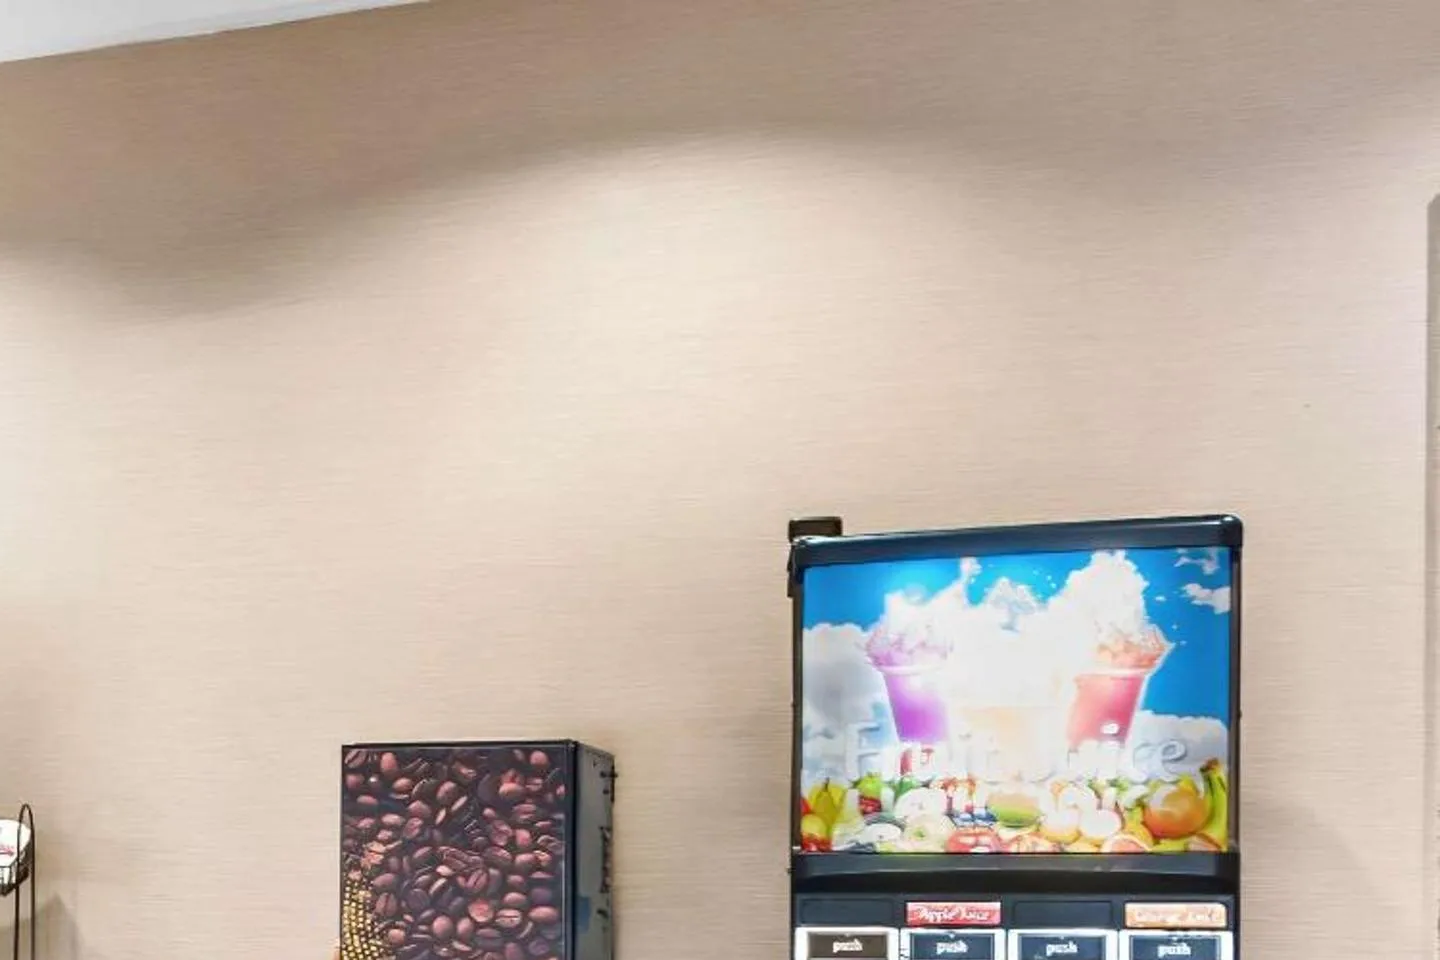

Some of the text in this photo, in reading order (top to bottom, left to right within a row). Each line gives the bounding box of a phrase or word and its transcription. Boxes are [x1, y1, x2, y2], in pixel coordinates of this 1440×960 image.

[832, 938, 863, 953] push
[936, 939, 968, 955] push
[1046, 941, 1078, 956] push
[1157, 942, 1191, 958] push
